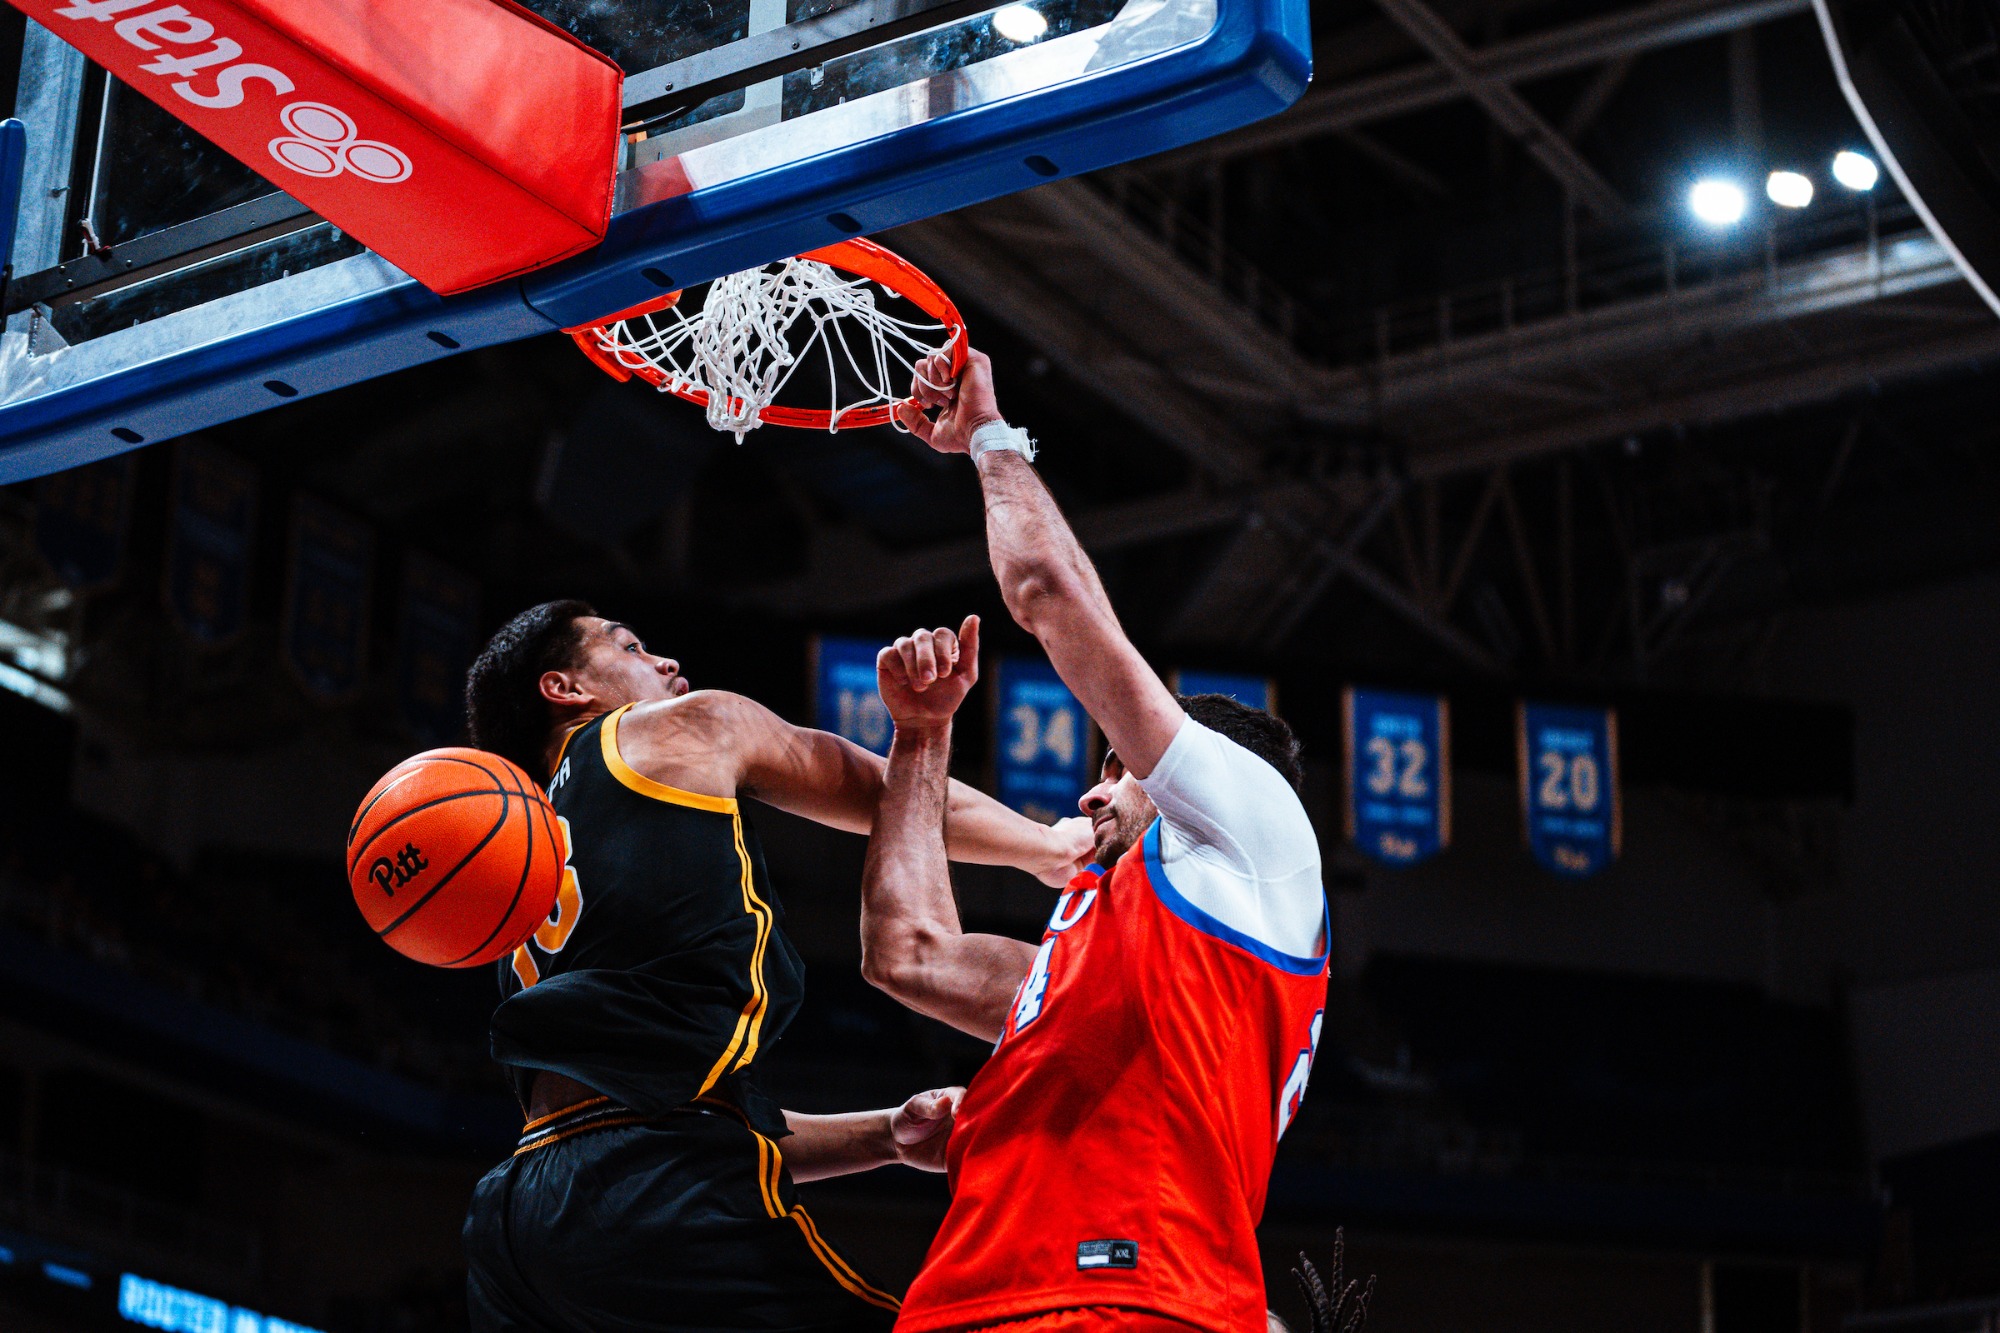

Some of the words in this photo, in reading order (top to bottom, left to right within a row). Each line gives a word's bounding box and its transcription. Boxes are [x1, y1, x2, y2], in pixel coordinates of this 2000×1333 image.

[1008, 704, 1076, 767] 34
[545, 756, 571, 803] PA
[1366, 736, 1429, 798] 32
[1539, 751, 1600, 812] 20
[368, 842, 430, 898] Pitt
